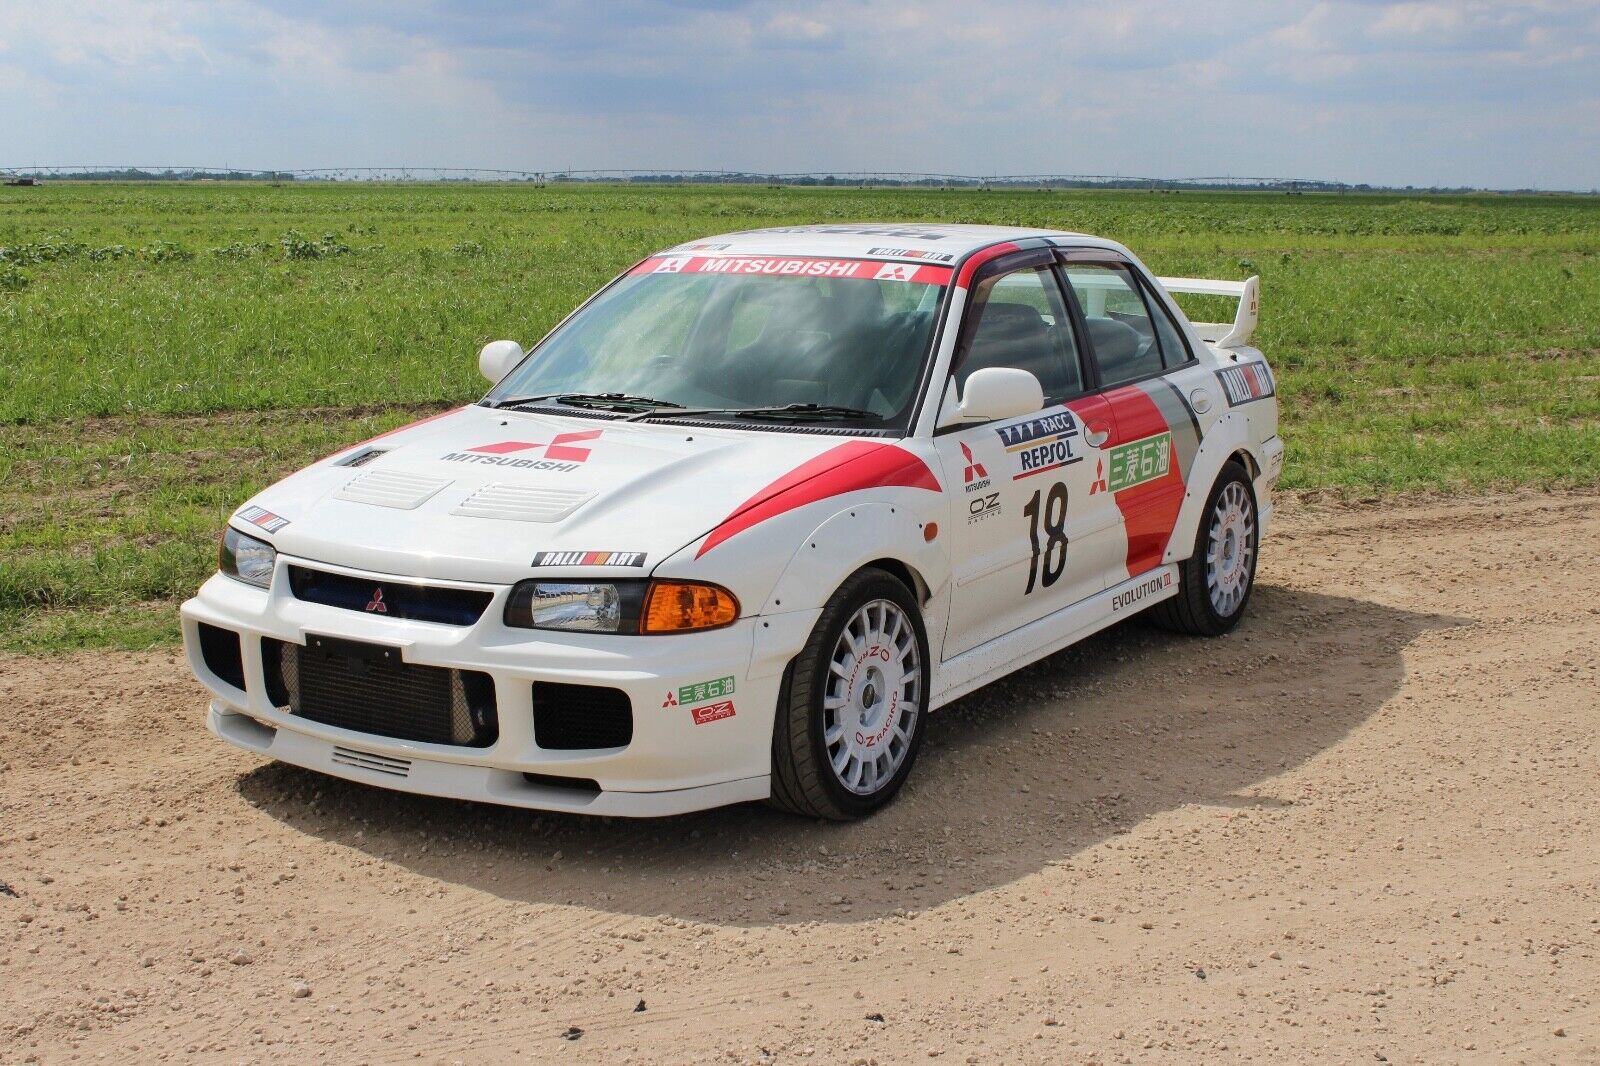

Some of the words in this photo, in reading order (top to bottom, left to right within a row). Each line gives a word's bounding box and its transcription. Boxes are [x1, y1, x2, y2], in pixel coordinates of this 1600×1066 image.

[698, 257, 861, 276] MITSUBISHI
[1040, 414, 1070, 433] RACC
[440, 453, 581, 473] MITSUBISHI
[1021, 440, 1073, 470] REPSOL
[1111, 437, 1168, 486] 三菱石油
[1024, 482, 1068, 595] 18
[1112, 576, 1162, 611] EVOLUTION
[681, 678, 734, 703] 三菱石油
